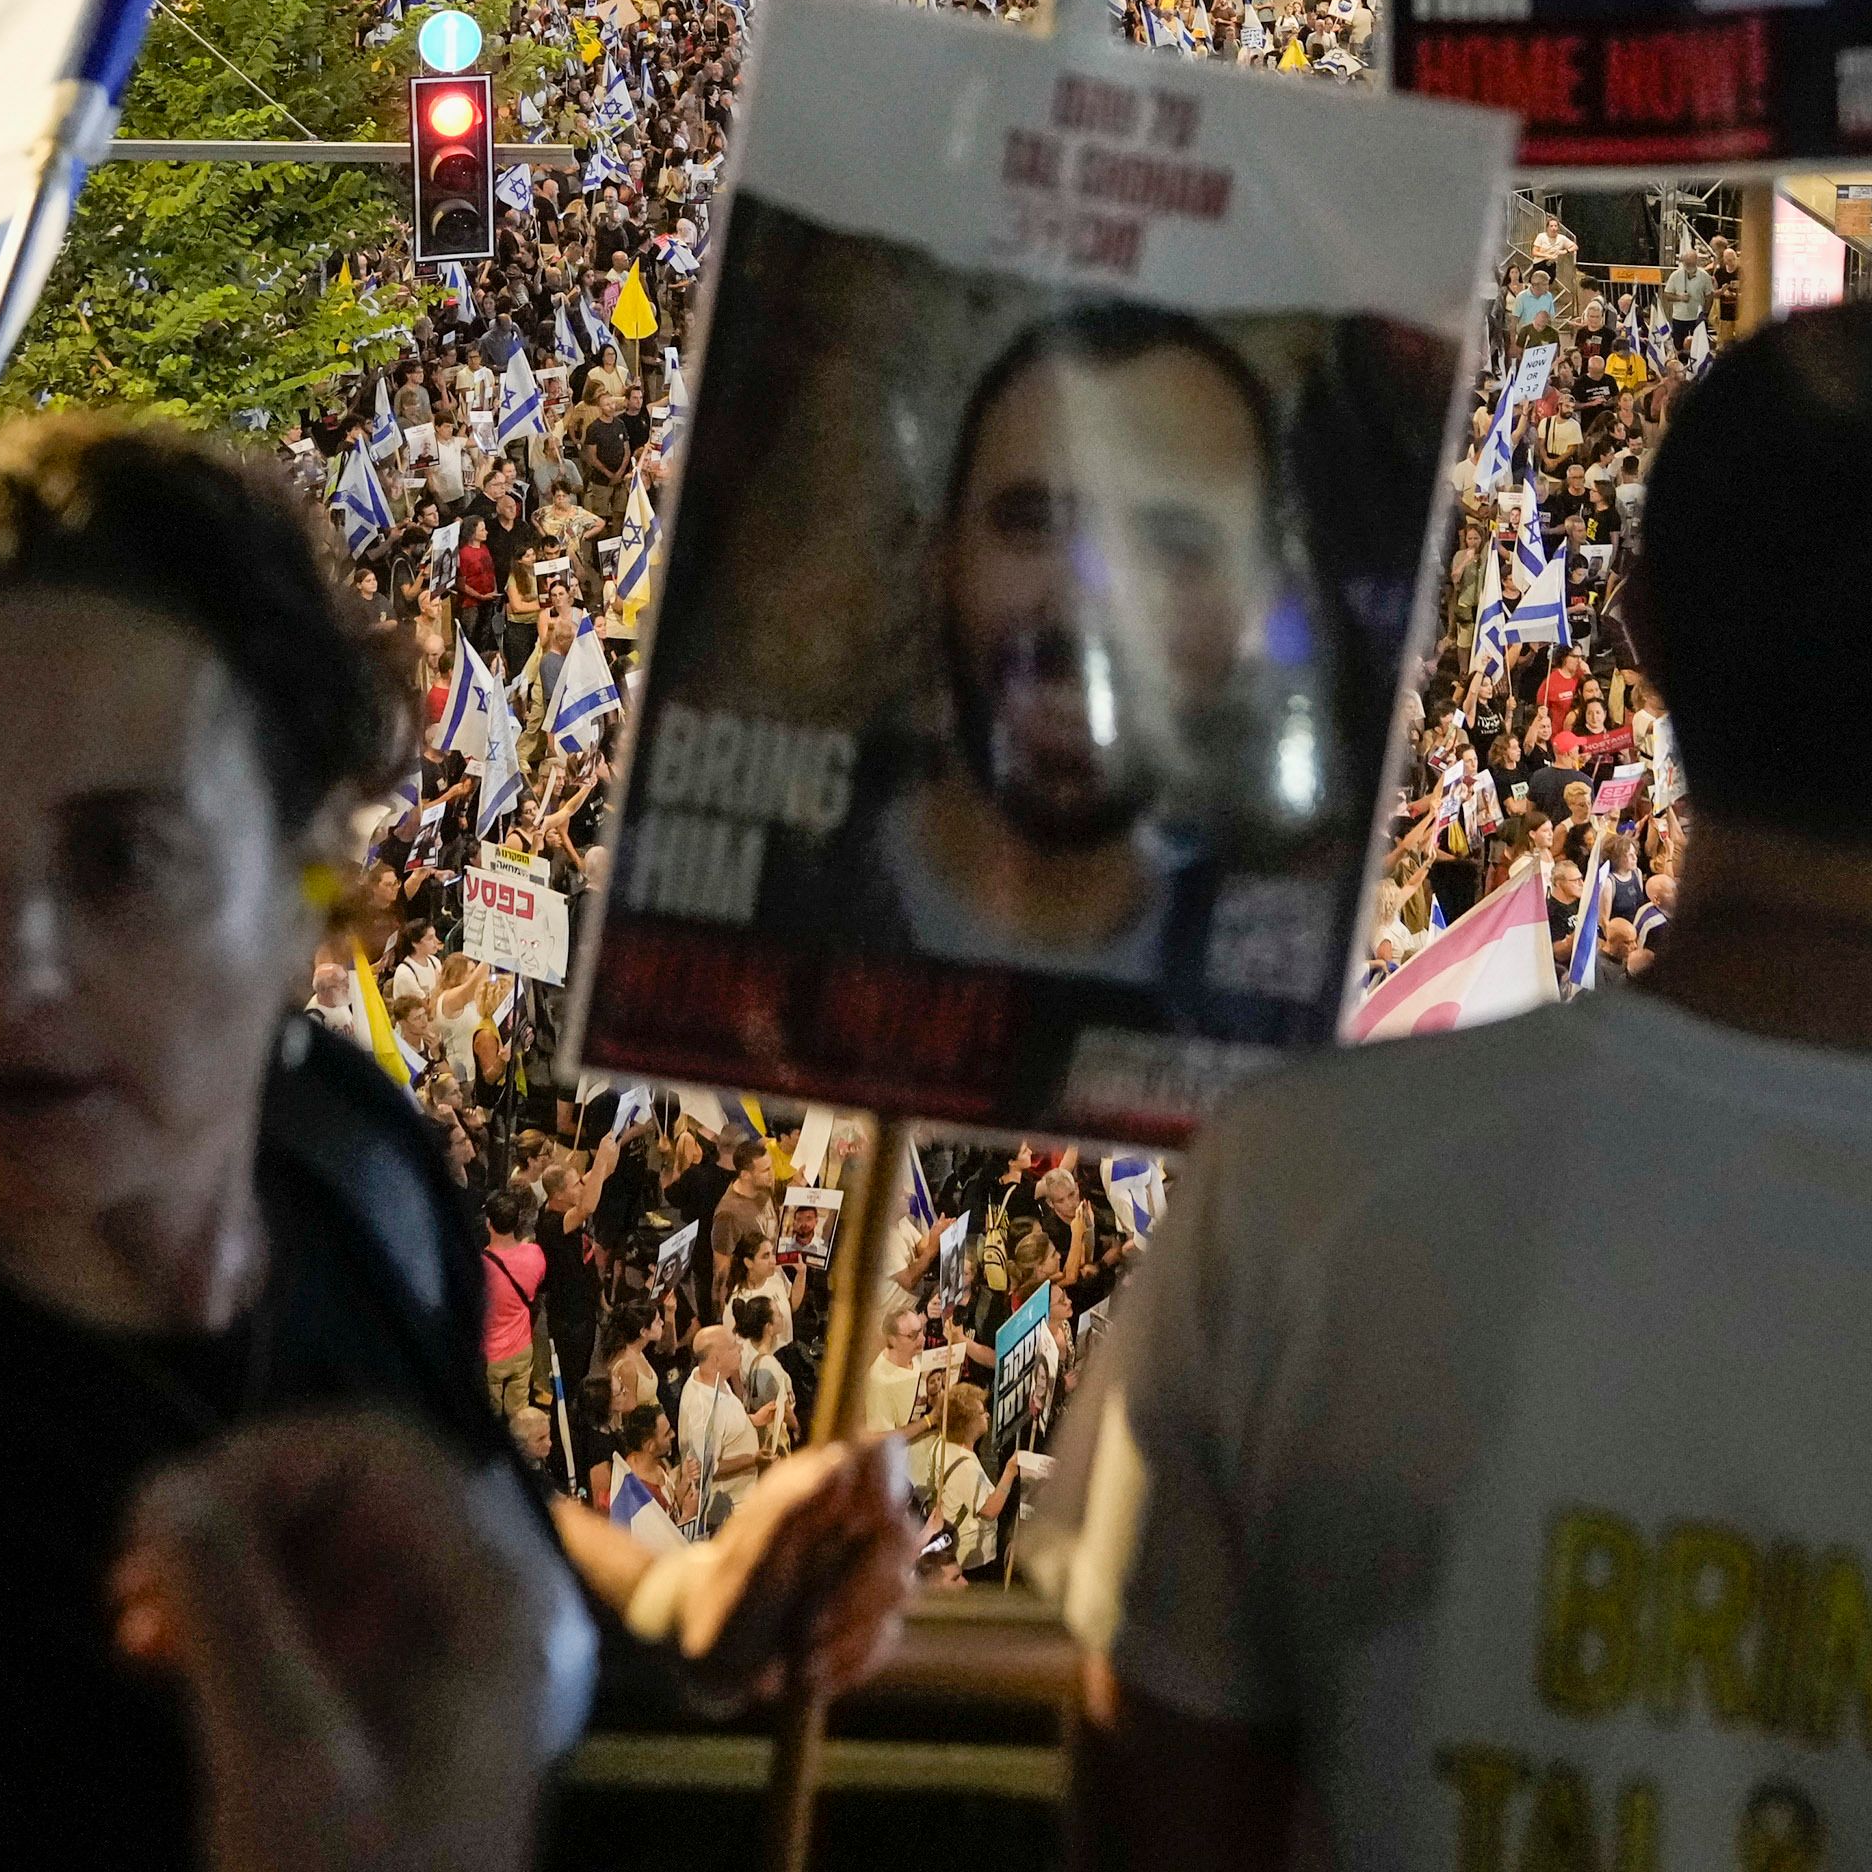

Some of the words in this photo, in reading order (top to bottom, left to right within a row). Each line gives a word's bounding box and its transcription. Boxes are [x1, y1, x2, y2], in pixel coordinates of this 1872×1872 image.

[1414, 33, 1583, 124] HOME
[1525, 359, 1546, 369] NOW
[648, 700, 857, 831] BRING
